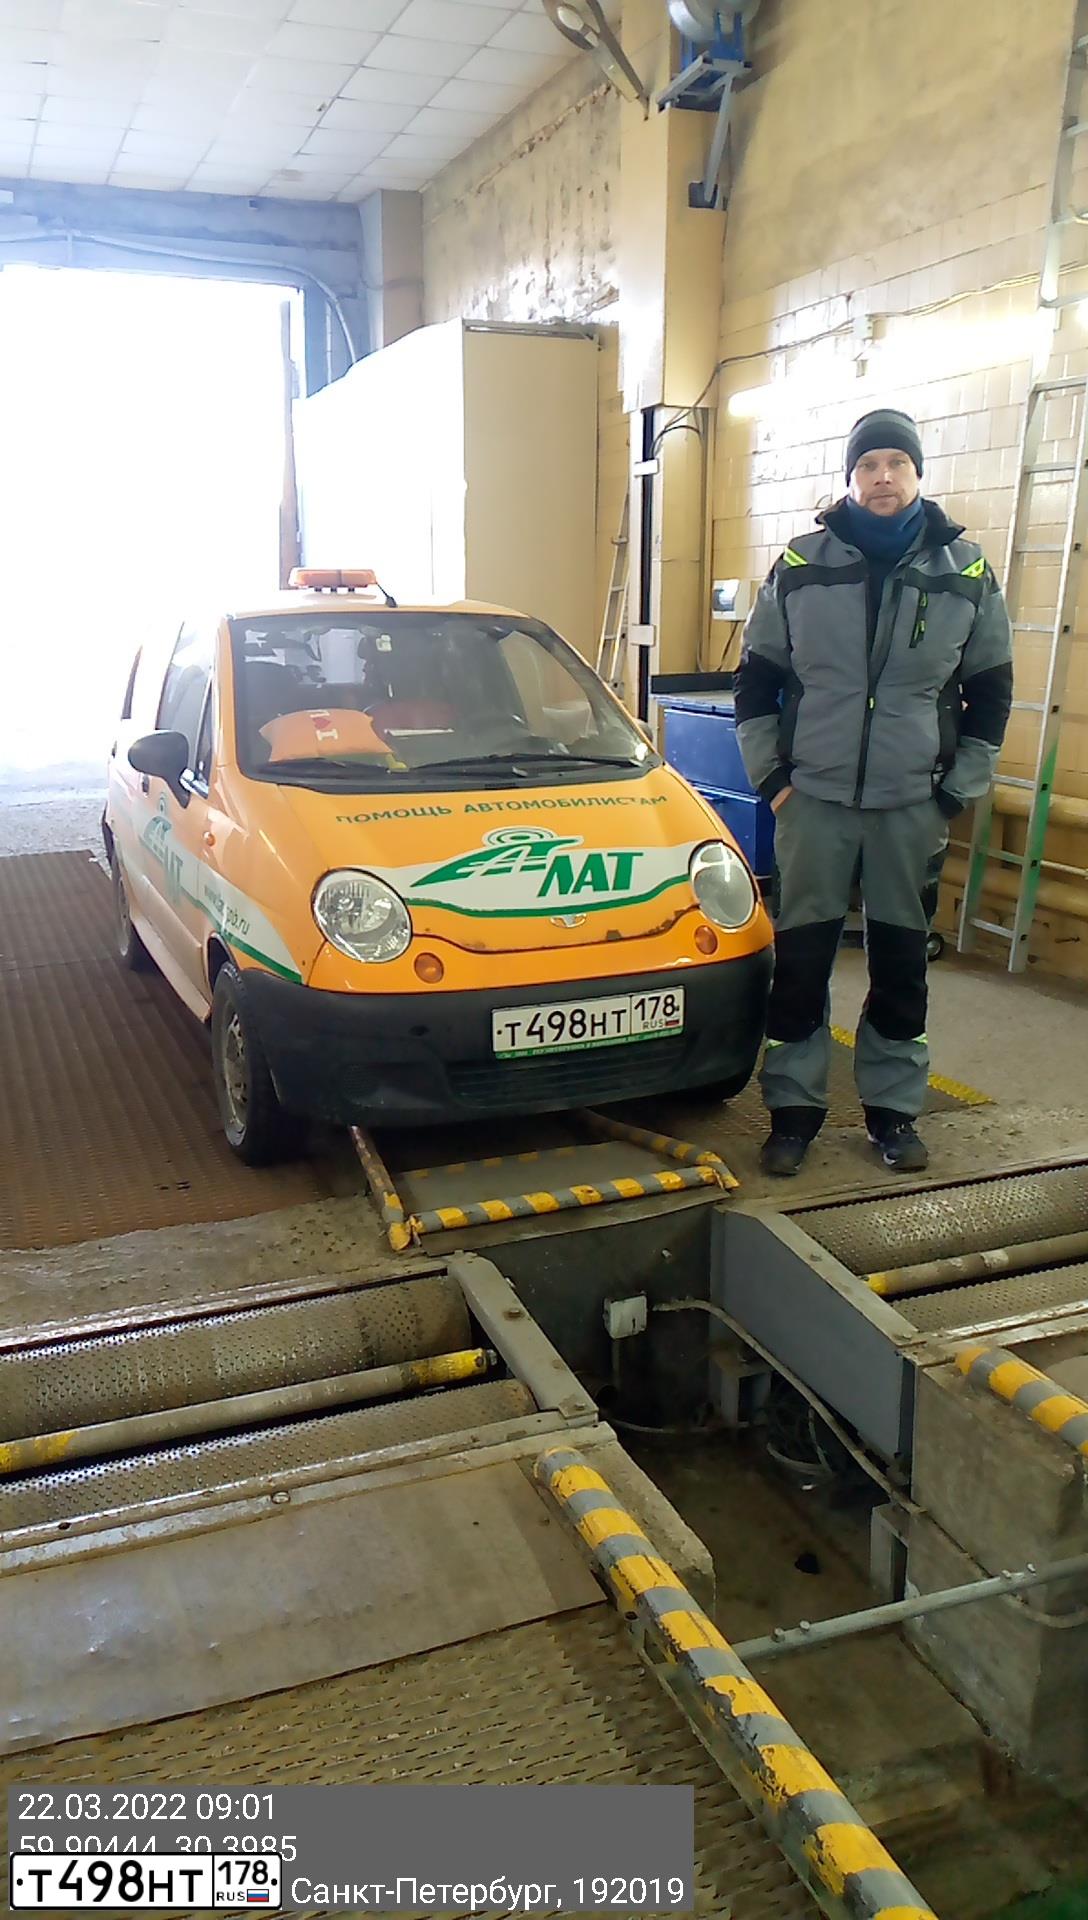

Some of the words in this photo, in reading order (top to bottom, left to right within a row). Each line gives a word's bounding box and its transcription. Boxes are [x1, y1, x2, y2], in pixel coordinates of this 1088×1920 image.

[336, 805, 452, 823] ПОМОЩЬ
[505, 1008, 627, 1047] Т498НТ
[634, 994, 676, 1021] 178
[642, 1017, 664, 1031] RUS
